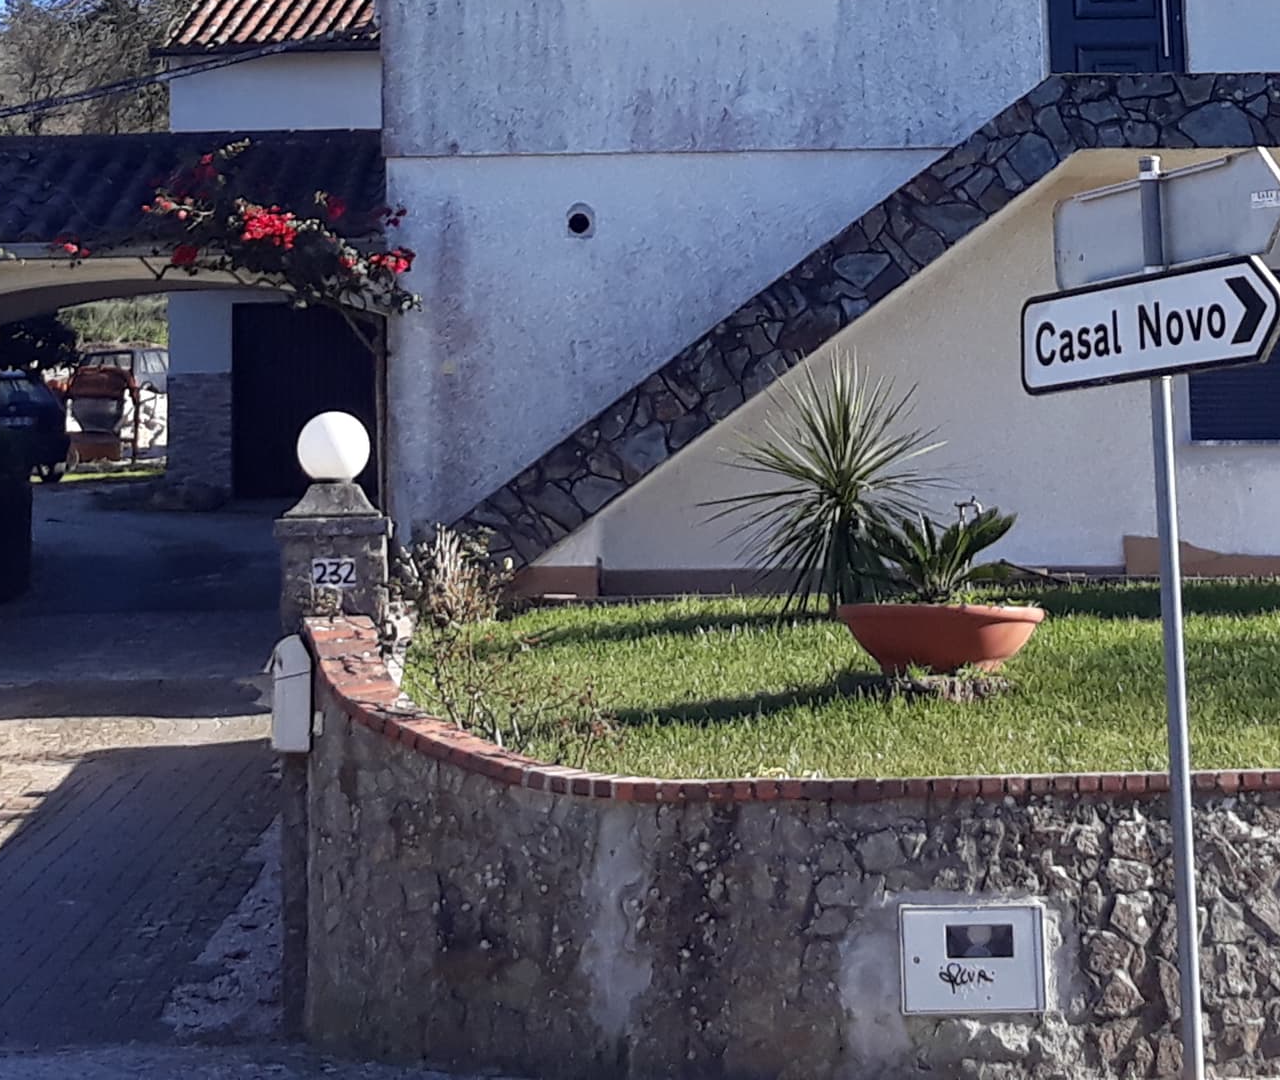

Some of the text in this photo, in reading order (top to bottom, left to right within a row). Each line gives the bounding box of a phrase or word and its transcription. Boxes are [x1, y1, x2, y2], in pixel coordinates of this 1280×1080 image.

[1035, 301, 1226, 366] Casal Novo
[314, 562, 357, 584] 232
